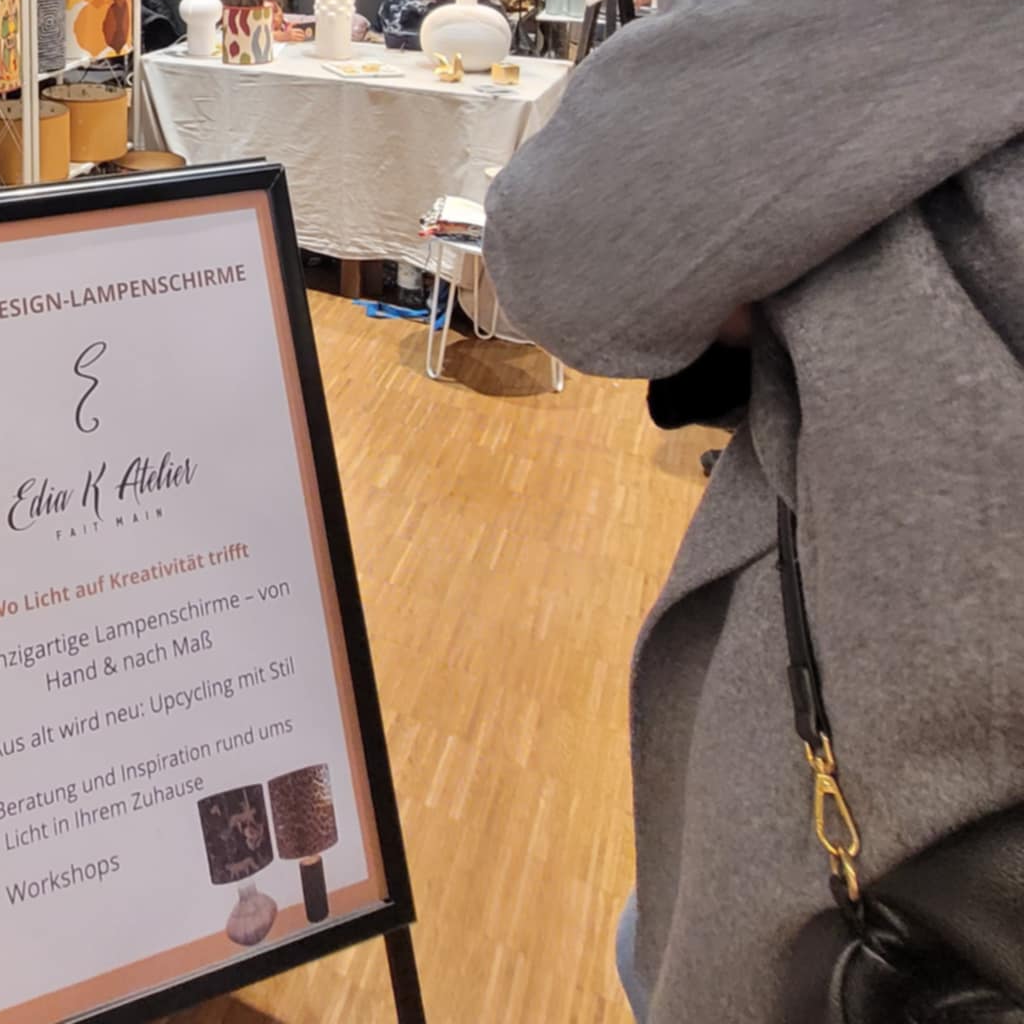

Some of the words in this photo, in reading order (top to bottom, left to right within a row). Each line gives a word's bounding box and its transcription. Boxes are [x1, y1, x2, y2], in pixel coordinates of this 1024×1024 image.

[6, 477, 74, 532] Edia
[81, 461, 107, 522] K
[114, 451, 198, 505] Atelier
[55, 521, 100, 541] FAIT
[115, 507, 163, 528] MAIN
[23, 586, 71, 612] Licht
[75, 575, 105, 599] auf
[109, 554, 205, 590] Kreativität
[208, 542, 249, 566] trifft
[94, 594, 241, 644] Lampenschirme
[257, 581, 291, 601] von
[45, 659, 98, 692] Hand
[103, 655, 118, 676] &
[122, 642, 168, 671] nach
[172, 629, 213, 657] Maß
[30, 725, 55, 749] alt
[58, 711, 100, 740] wird
[105, 702, 145, 727] neu:
[149, 677, 235, 716] Upcycling
[237, 667, 267, 689] mit
[268, 655, 295, 681] Stil
[81, 766, 116, 794] und
[120, 743, 212, 783] Inspiration
[215, 726, 255, 753] rund
[258, 719, 293, 741] ums
[4, 823, 49, 851] Licht
[52, 816, 70, 836] in
[74, 800, 128, 829] Ihrem
[130, 776, 204, 812] Zuhause
[5, 855, 121, 905] Workshops
